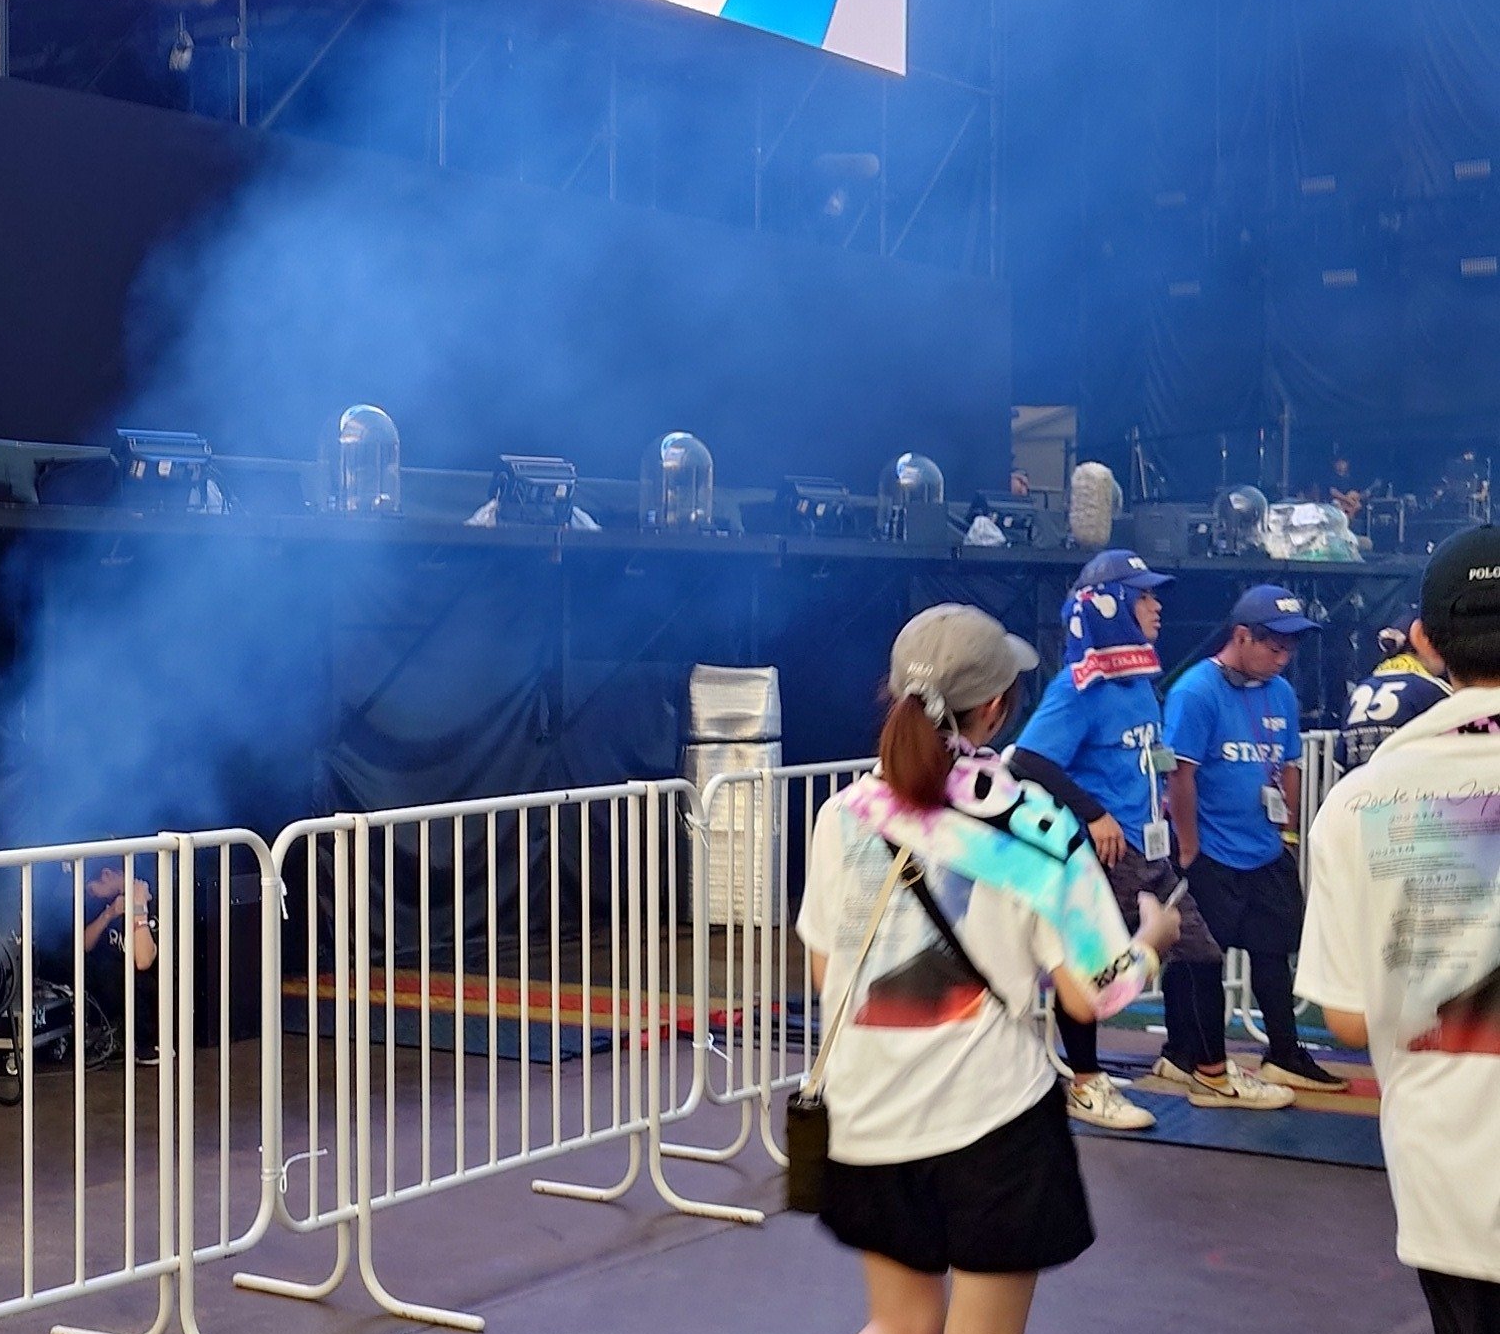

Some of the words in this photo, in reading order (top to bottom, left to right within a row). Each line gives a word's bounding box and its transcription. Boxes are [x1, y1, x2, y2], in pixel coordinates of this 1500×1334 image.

[1347, 680, 1408, 725] 25
[1121, 722, 1163, 749] STA
[1221, 741, 1286, 764] STAFF
